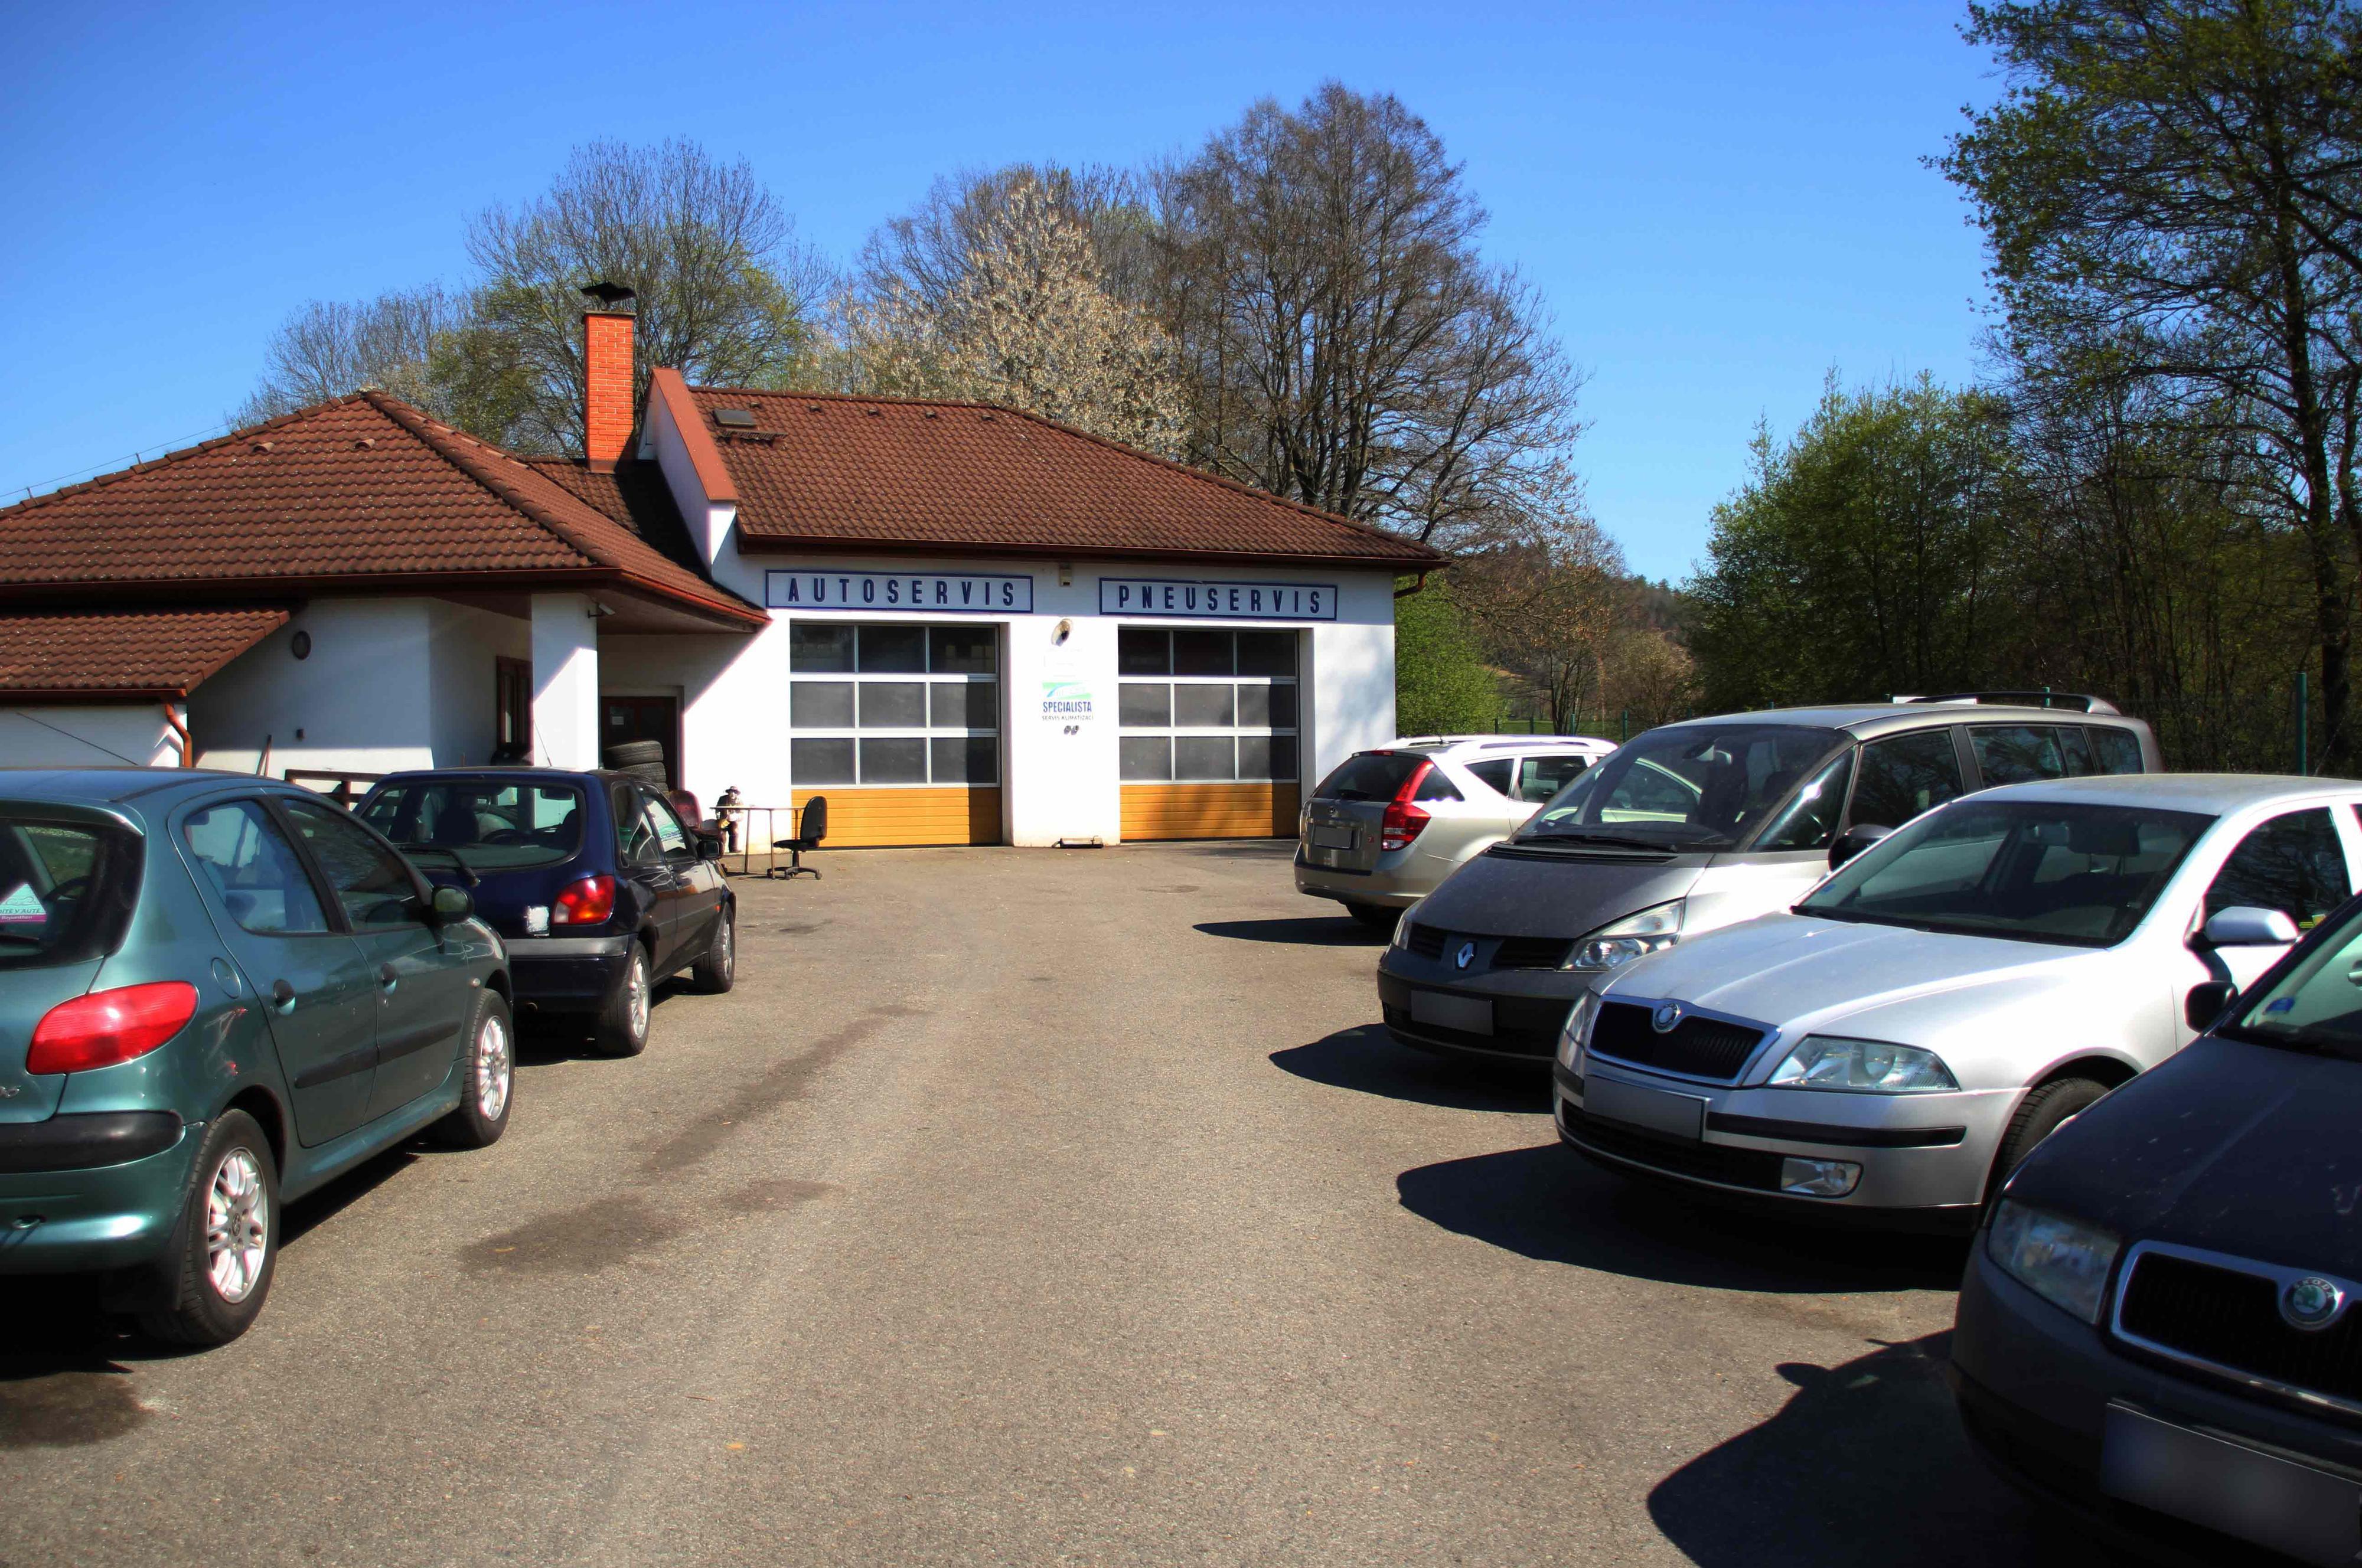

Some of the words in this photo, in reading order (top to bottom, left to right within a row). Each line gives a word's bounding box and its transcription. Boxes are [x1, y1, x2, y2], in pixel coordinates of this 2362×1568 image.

[788, 577, 1014, 606] AUTOSERVIS
[1118, 585, 1320, 614] PNEUSERVIS
[1043, 701, 1092, 713] SPECIALISTA
